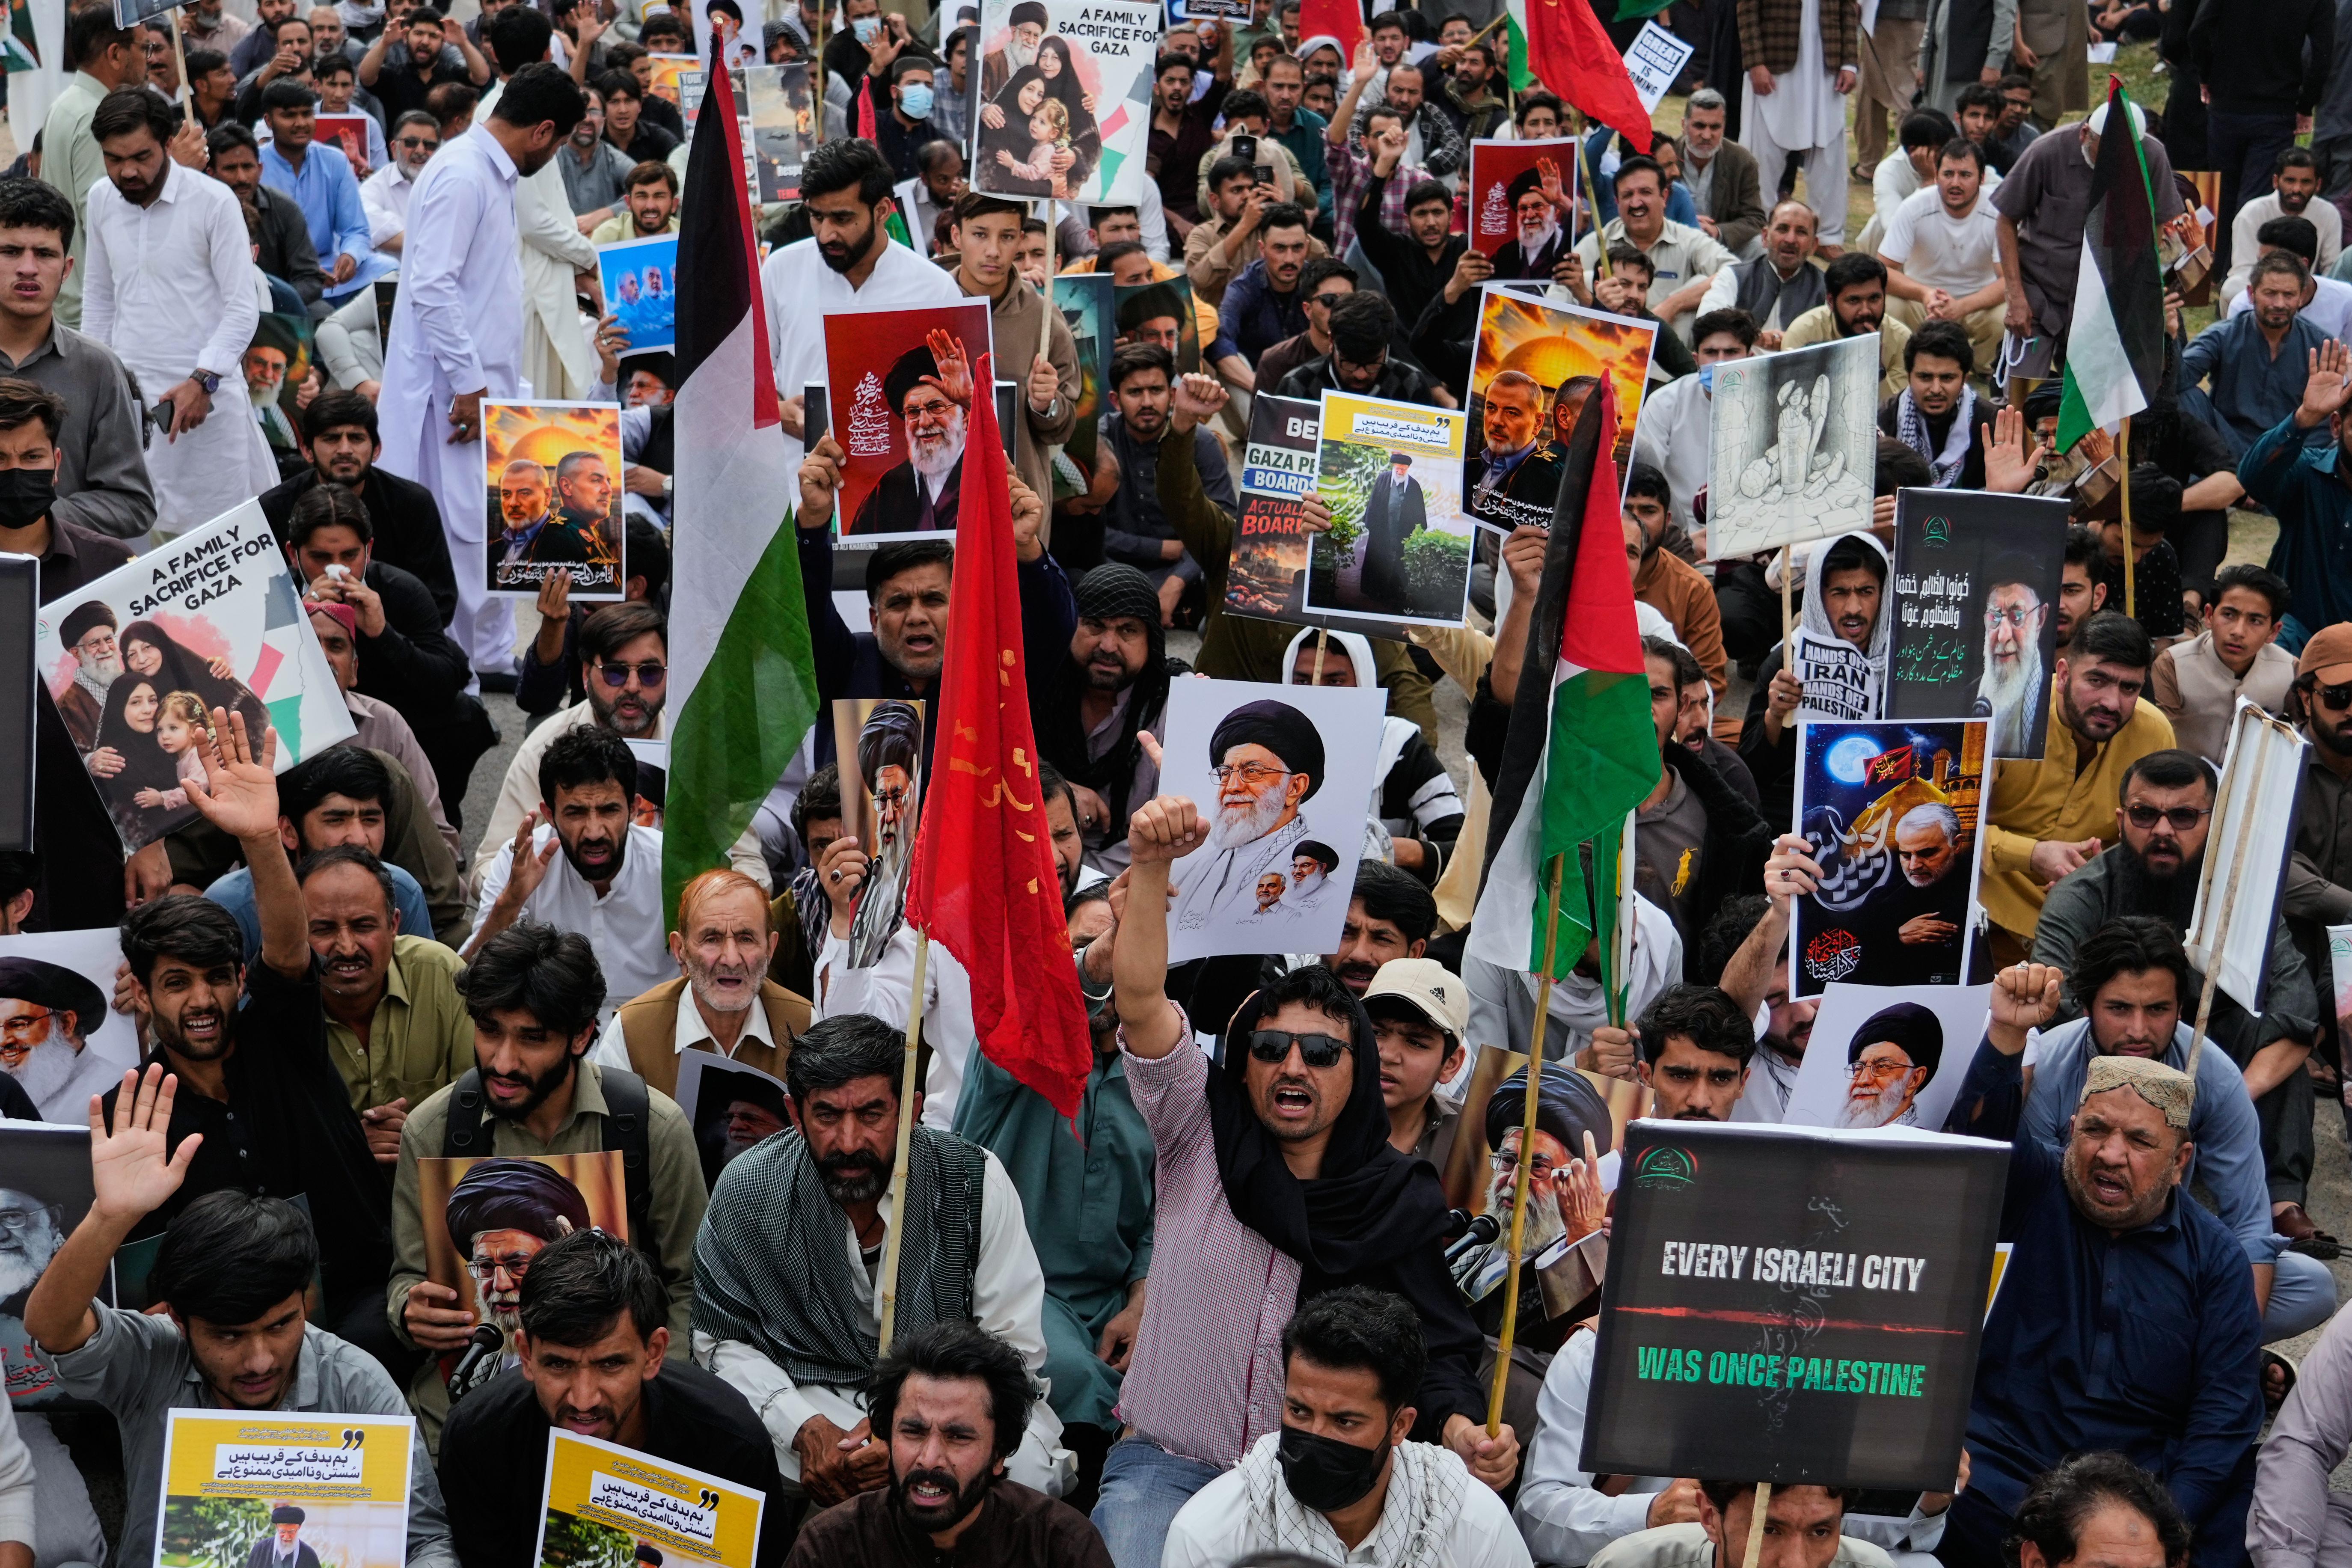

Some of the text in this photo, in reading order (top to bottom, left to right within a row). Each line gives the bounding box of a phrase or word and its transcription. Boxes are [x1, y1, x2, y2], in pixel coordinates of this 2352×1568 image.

[1080, 8, 1146, 26] A FAMILY
[1058, 21, 1130, 41] SACRIFICE
[1091, 41, 1130, 56] GAZA
[1642, 33, 1684, 64] GREAT
[1641, 65, 1652, 77] IS
[1362, 419, 1376, 428] ہیں
[1377, 421, 1398, 429] قریب
[1412, 425, 1429, 436] ہدف
[1248, 448, 1293, 471] GAZA
[153, 526, 239, 585] A FAMILY
[130, 534, 273, 616] SACRIFICE FOR
[185, 575, 242, 610] GAZA
[1805, 644, 1846, 664] HANDS
[1896, 645, 1907, 658] اور
[1915, 634, 1936, 662] دشمن
[1936, 640, 1949, 659] کے
[1949, 638, 1966, 668] ظالم
[1804, 662, 1865, 691] IRAN
[1927, 663, 1939, 682] کے
[1939, 664, 1963, 689] مظلوم
[1803, 682, 1865, 711] HANDS OFF
[1429, 989, 1446, 1005] adidas
[1661, 1241, 1926, 1292] EVERY ISRAELI CITY
[1638, 1346, 1926, 1397] WAS ONCE PALESTINE
[229, 1448, 348, 1467] ہم ہدف کے قریب ہیں
[217, 1466, 232, 1478] ہے
[233, 1466, 271, 1479] ممنوع
[591, 1495, 605, 1506] ہے
[602, 1482, 704, 1526] ہم ہدف کے قریب ہیں
[605, 1496, 638, 1512] ممنوع
